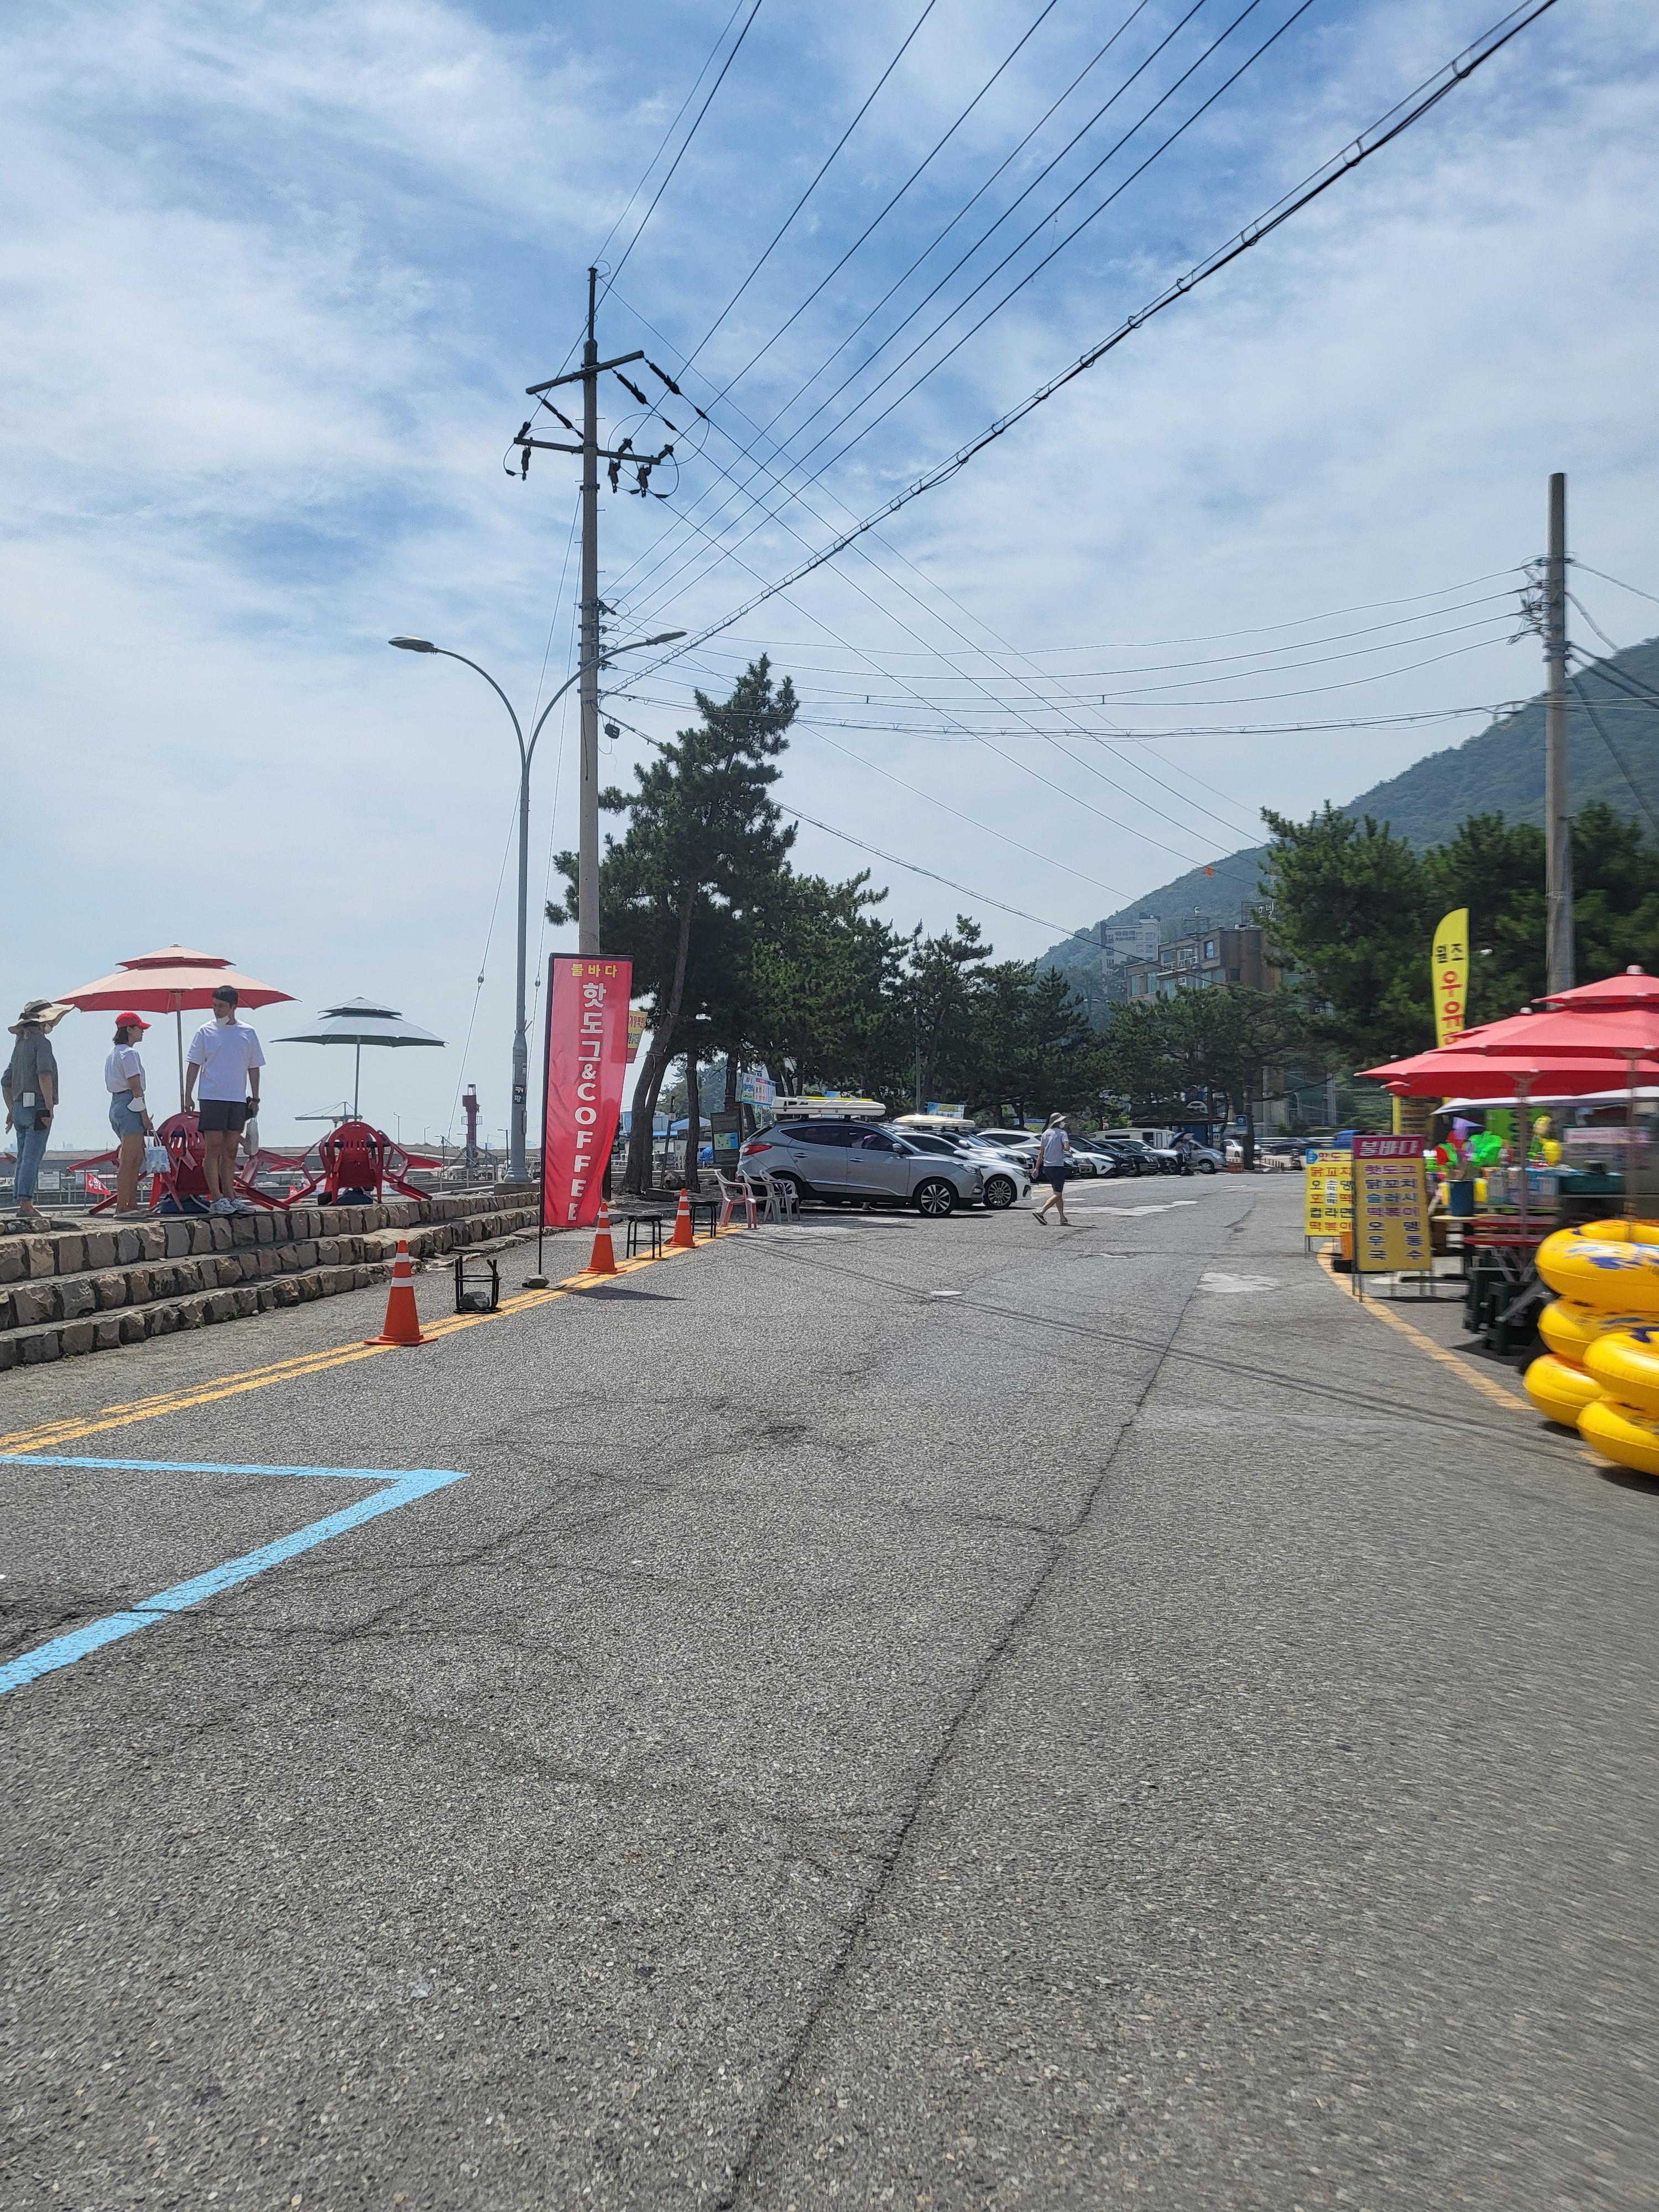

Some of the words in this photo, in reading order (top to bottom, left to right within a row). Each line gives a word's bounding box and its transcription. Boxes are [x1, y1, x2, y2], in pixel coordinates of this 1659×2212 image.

[571, 963, 618, 978] 불바다
[1359, 1140, 1419, 1156] 불바다
[1364, 1165, 1418, 1175] 핫도그
[1365, 1193, 1419, 1204] 슬러시
